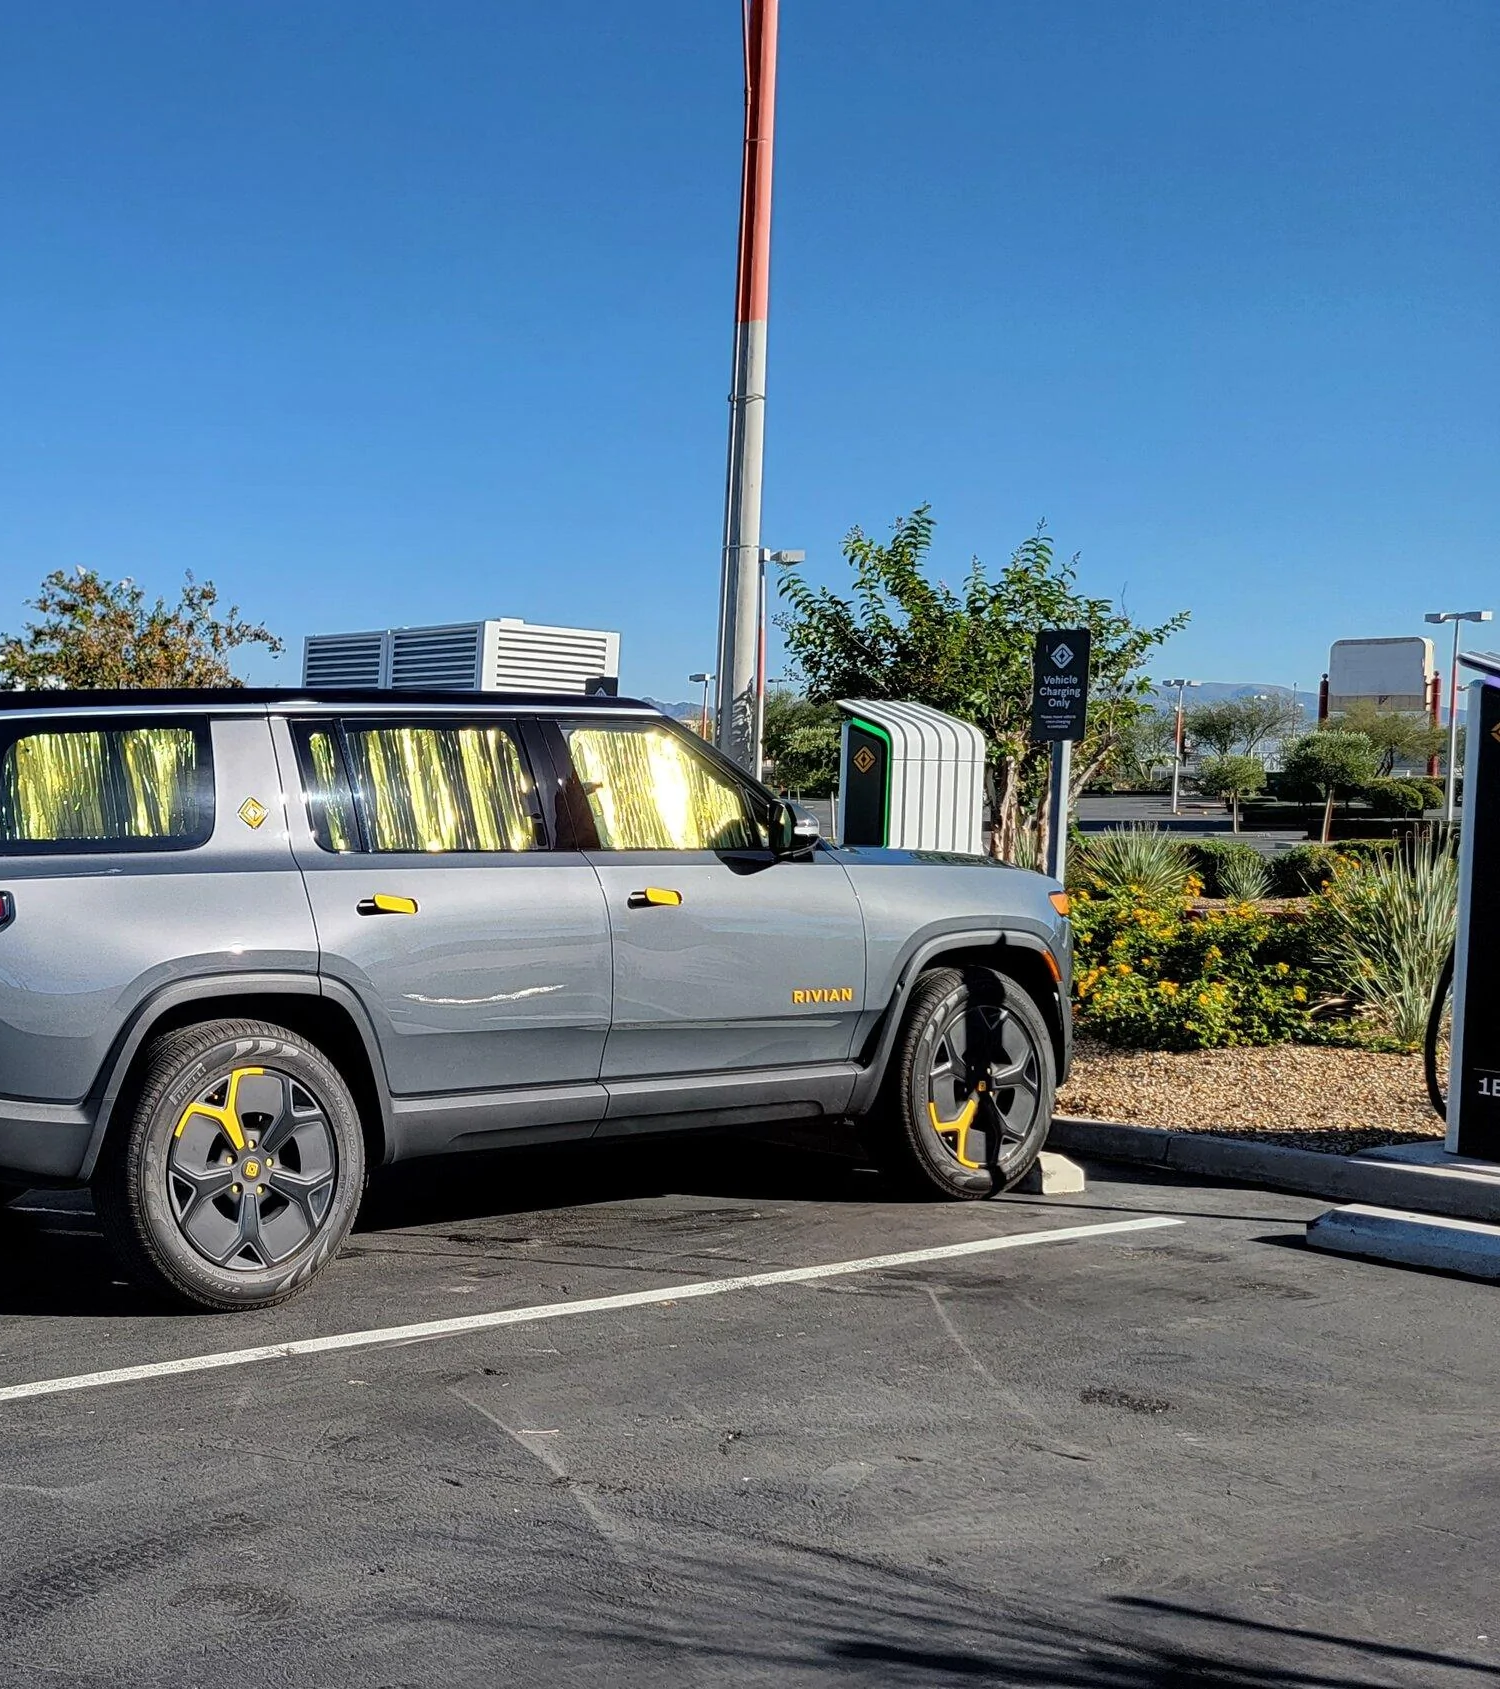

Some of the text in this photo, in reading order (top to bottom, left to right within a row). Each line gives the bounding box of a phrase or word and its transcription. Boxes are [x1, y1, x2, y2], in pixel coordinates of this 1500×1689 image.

[1043, 675, 1078, 685] Vehicle
[1039, 686, 1081, 698] Charging
[1048, 698, 1070, 709] Only
[793, 987, 853, 1004] RIVIAN
[169, 1062, 207, 1105] PIRELLI
